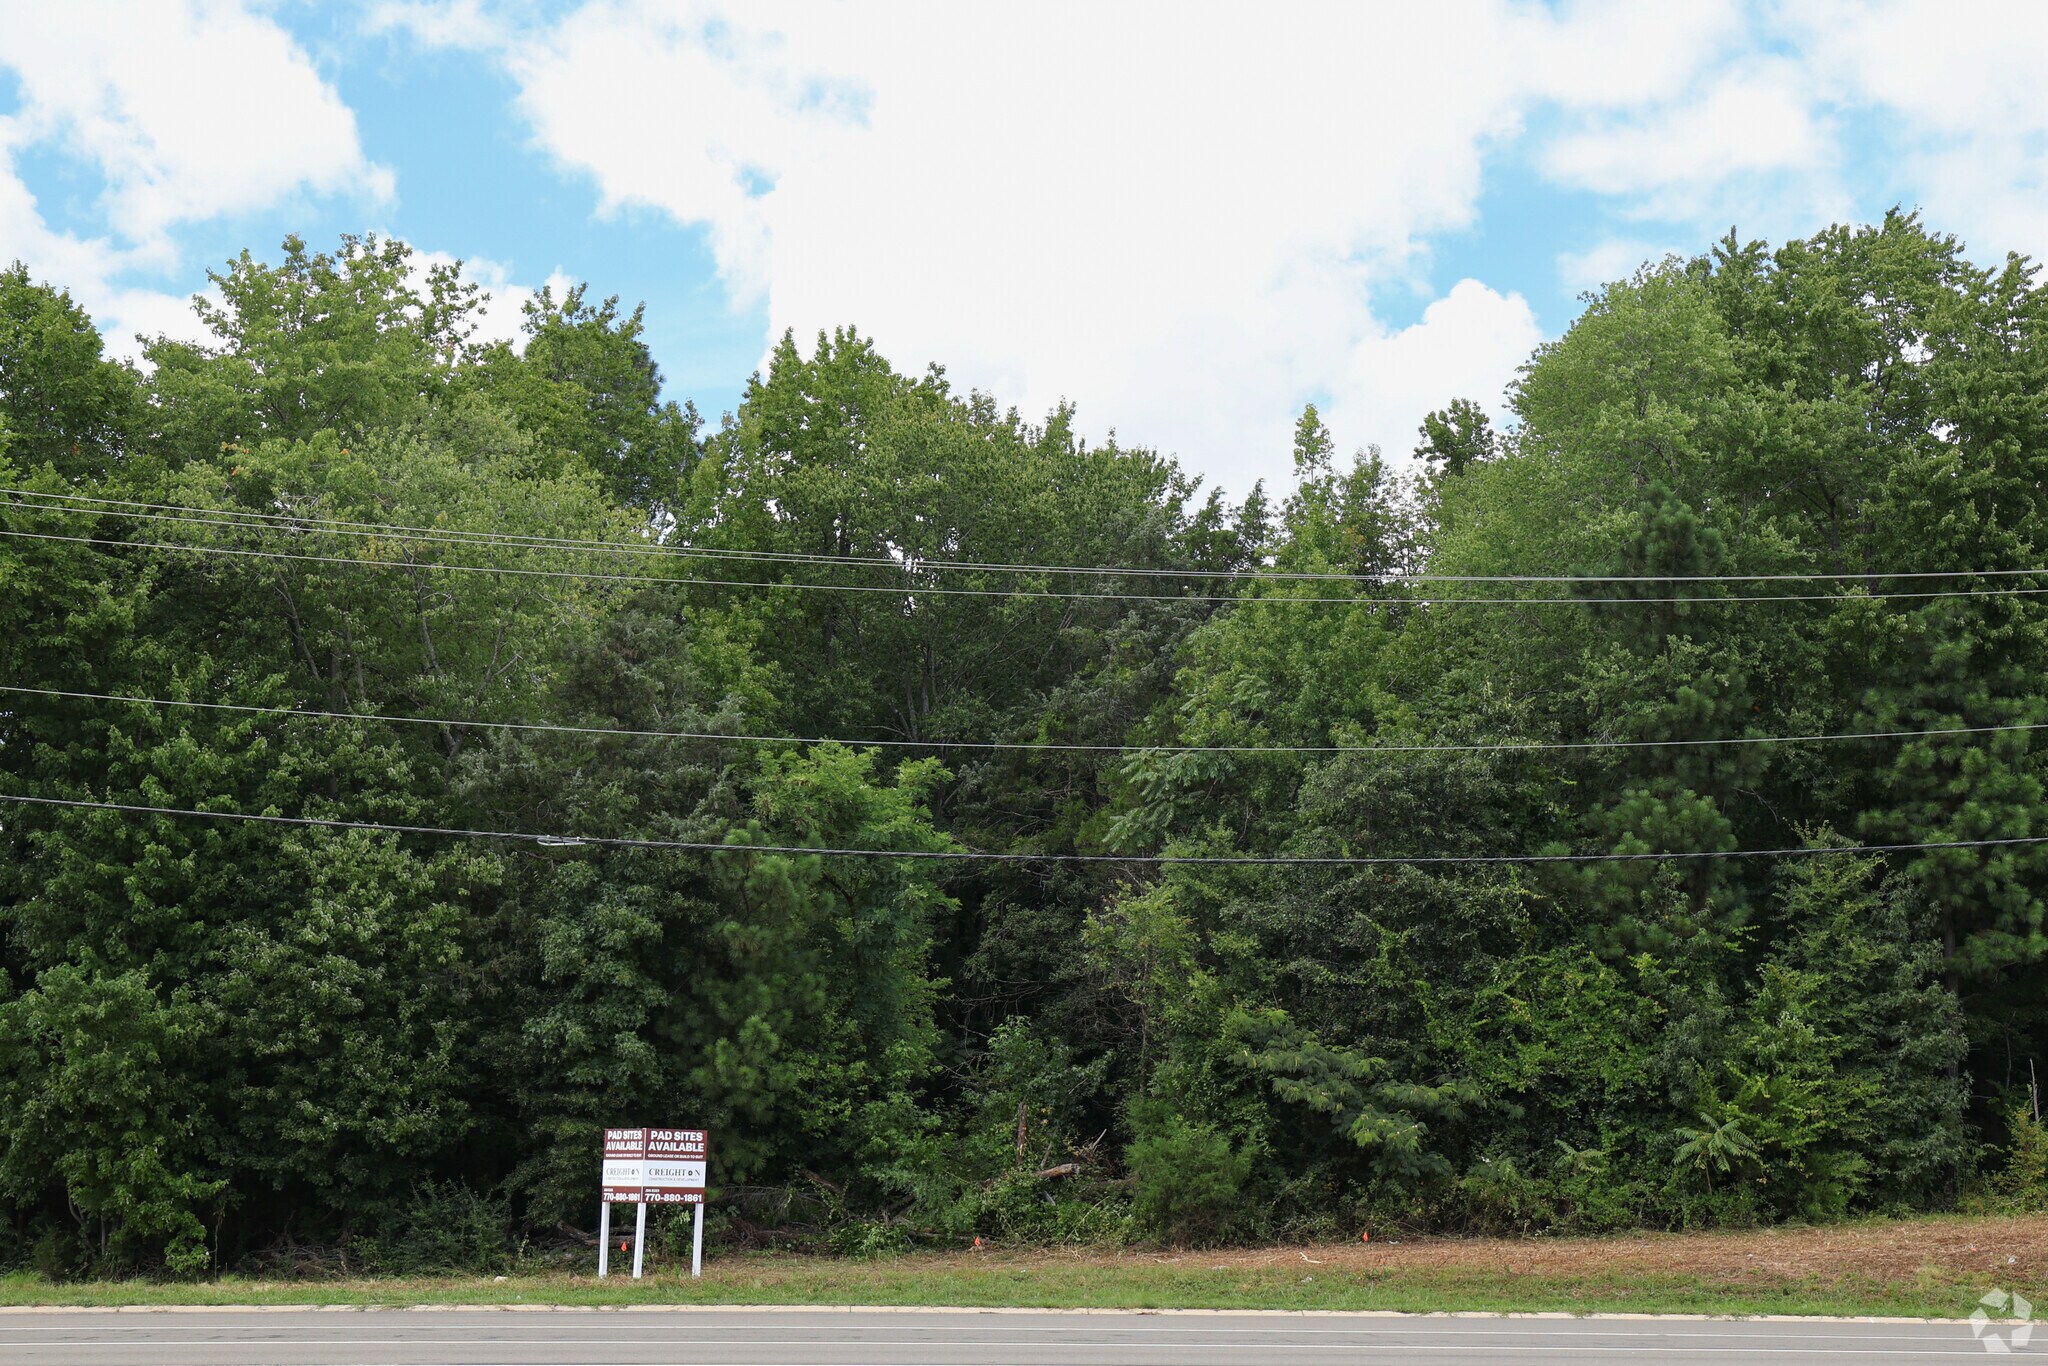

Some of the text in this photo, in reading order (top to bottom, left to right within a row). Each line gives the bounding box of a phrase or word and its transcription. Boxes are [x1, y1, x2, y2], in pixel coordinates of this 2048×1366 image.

[608, 1130, 642, 1140] PAD SITES
[650, 1131, 703, 1141] PAD SITES
[606, 1141, 643, 1151] AVAILABLE
[648, 1142, 704, 1152] AVAILABLE
[645, 1193, 702, 1202] 770-880-1861
